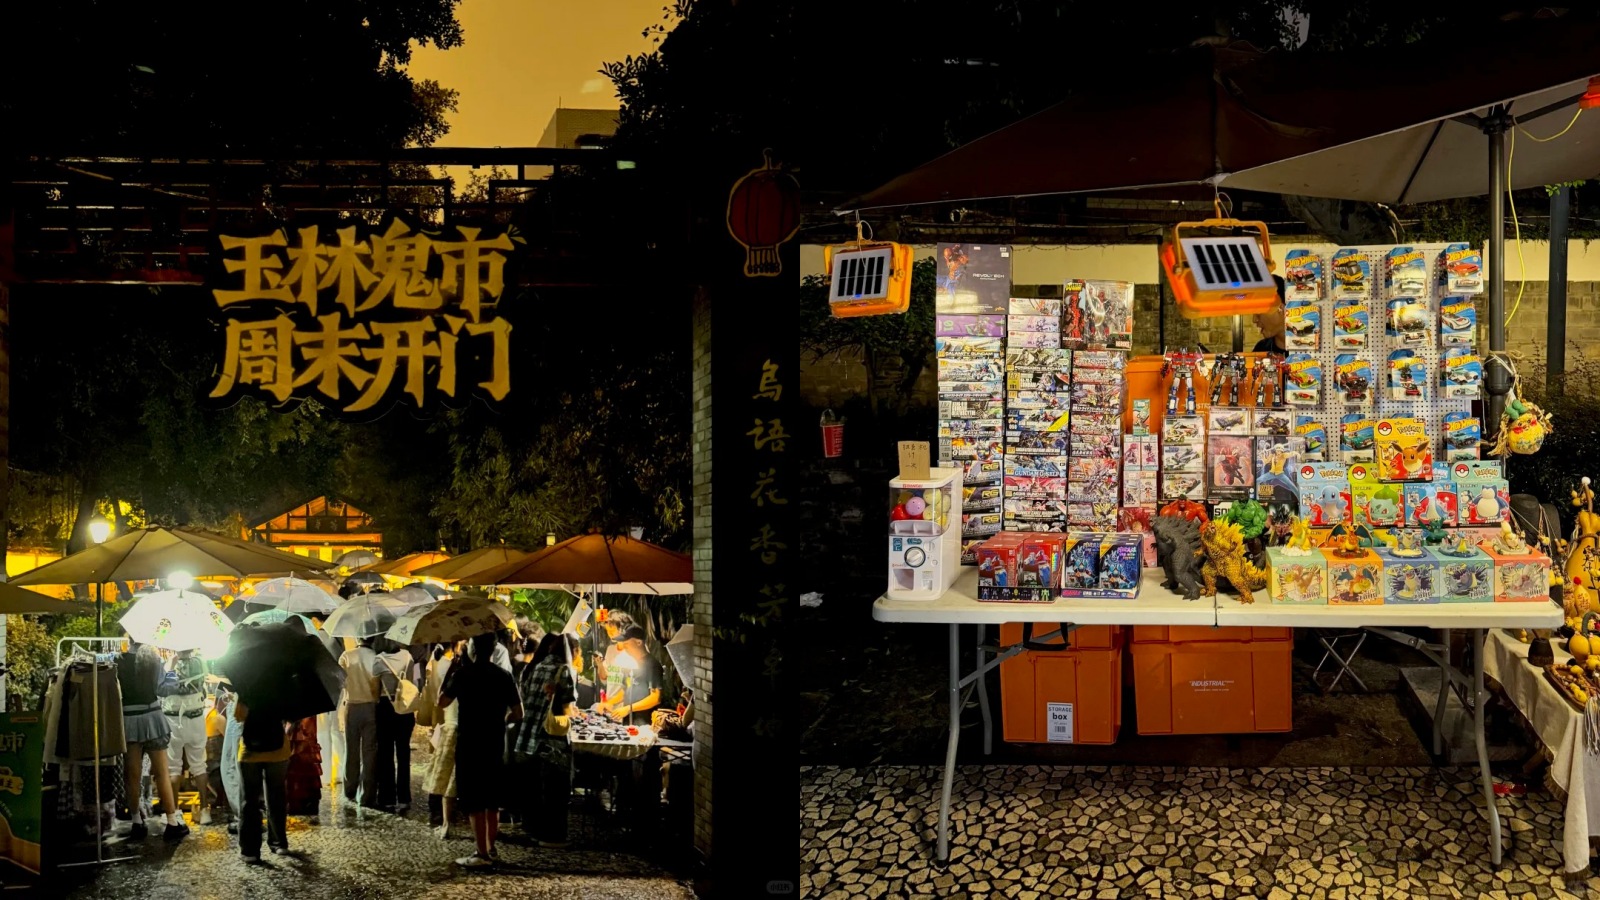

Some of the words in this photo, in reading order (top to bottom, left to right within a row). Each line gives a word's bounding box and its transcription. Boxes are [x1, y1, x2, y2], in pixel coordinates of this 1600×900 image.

[212, 217, 515, 323] 玉林鬼市
[209, 312, 513, 412] 周末开门
[1052, 712, 1068, 720] box
